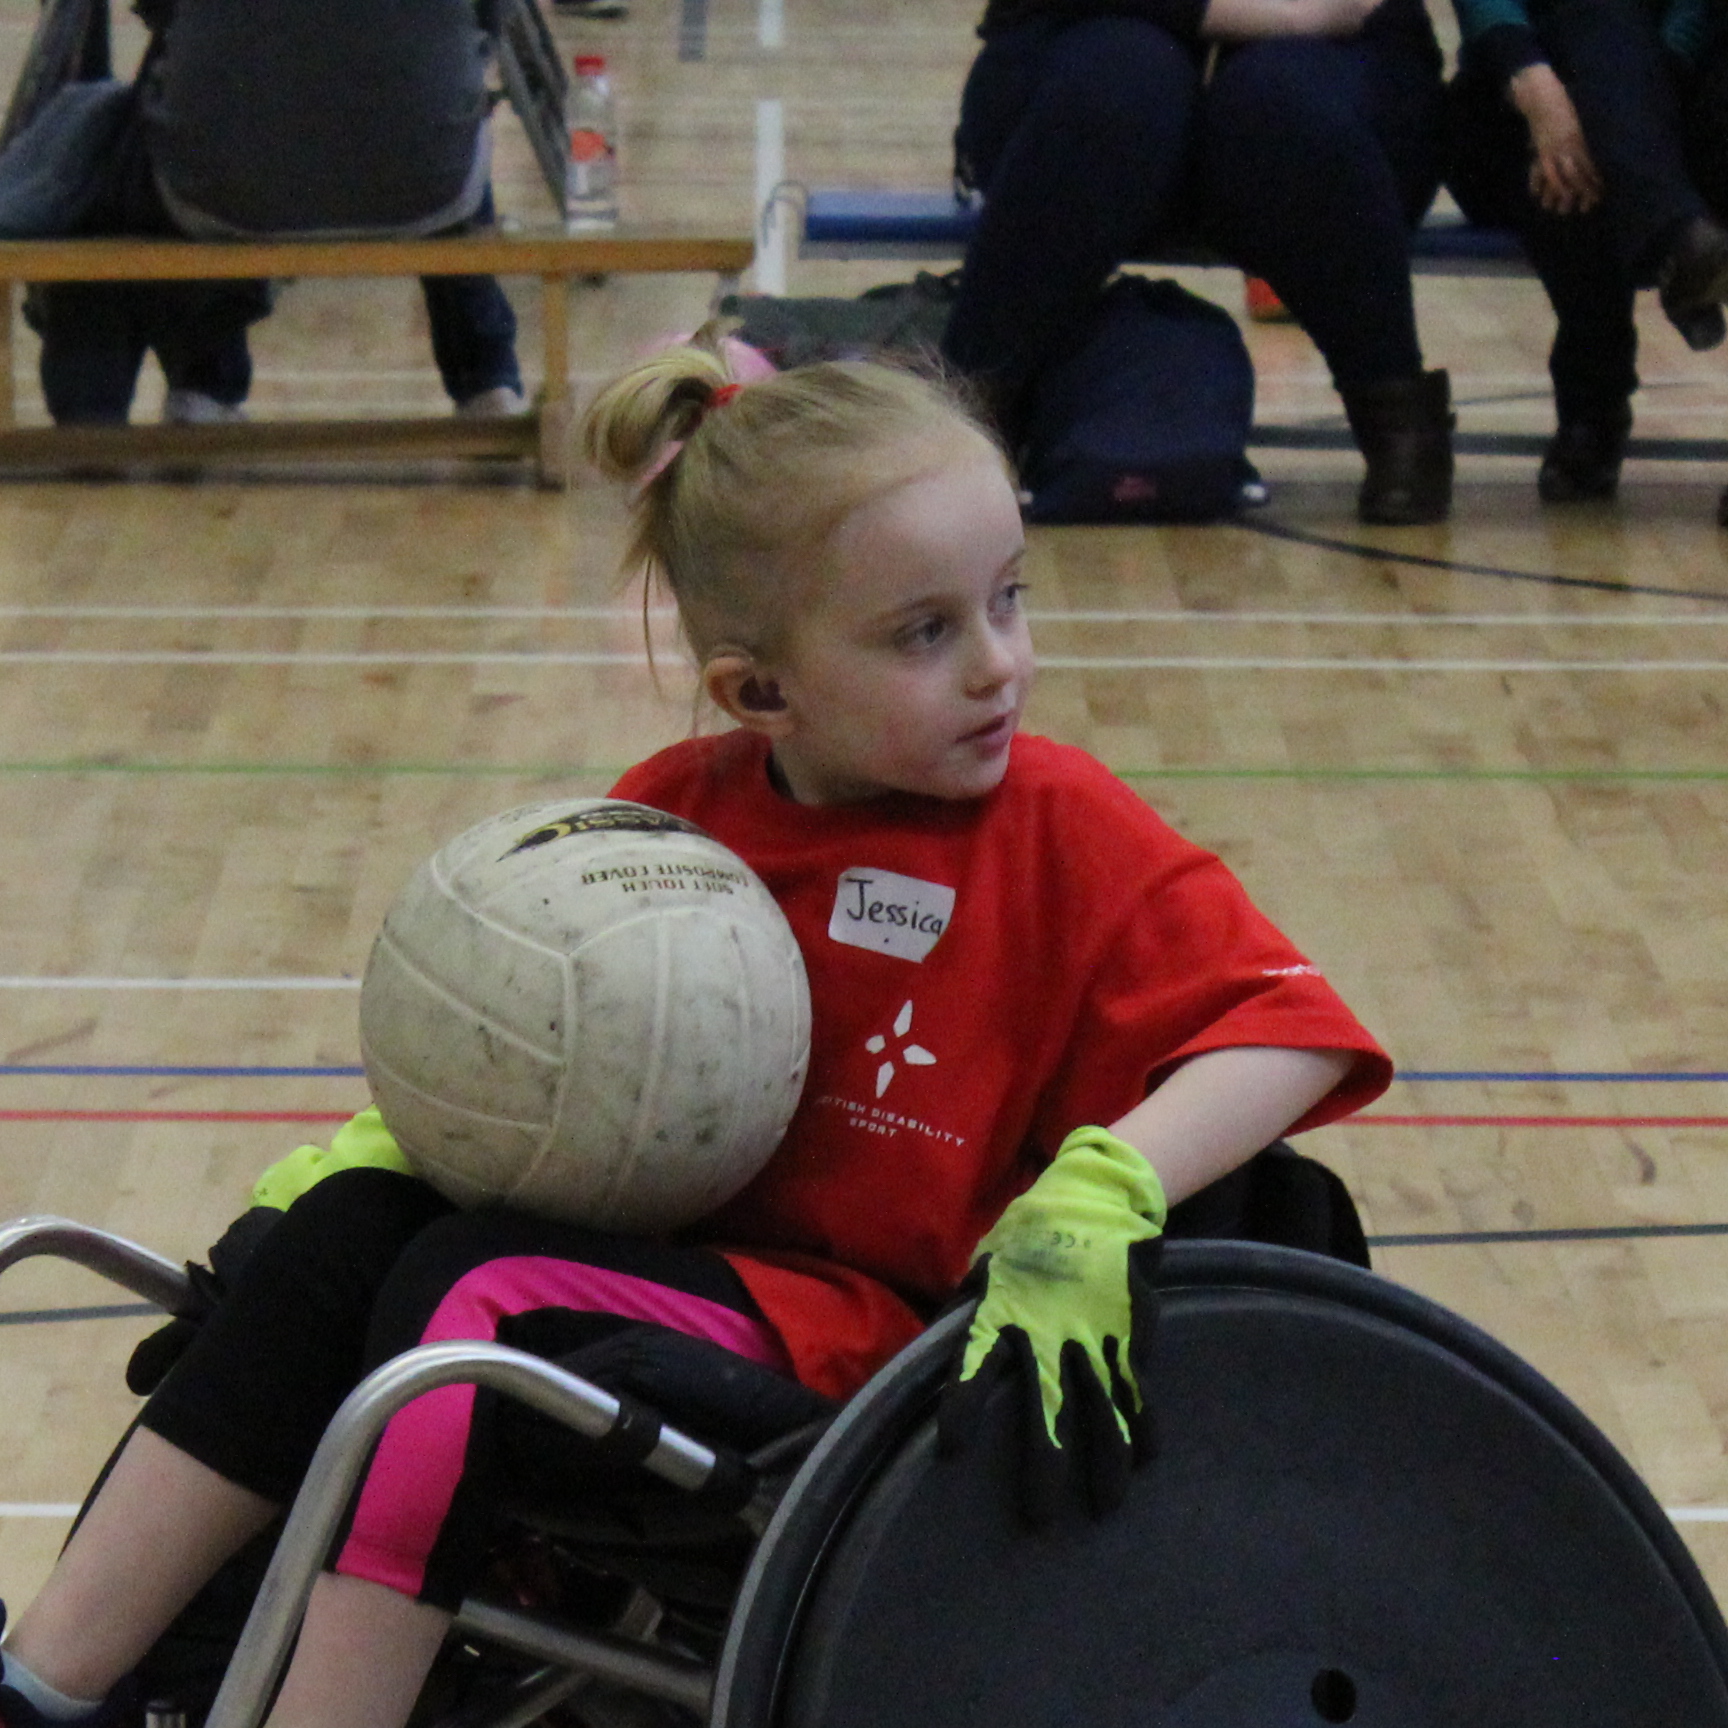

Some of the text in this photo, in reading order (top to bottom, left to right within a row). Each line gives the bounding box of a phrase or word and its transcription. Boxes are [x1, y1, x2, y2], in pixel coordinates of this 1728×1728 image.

[581, 864, 751, 888] COMPOSITE COVER
[622, 879, 686, 893] TOUCH
[845, 877, 943, 935] Jessica
[849, 1117, 897, 1138] SPORT
[871, 1107, 965, 1147] DISABILITY
